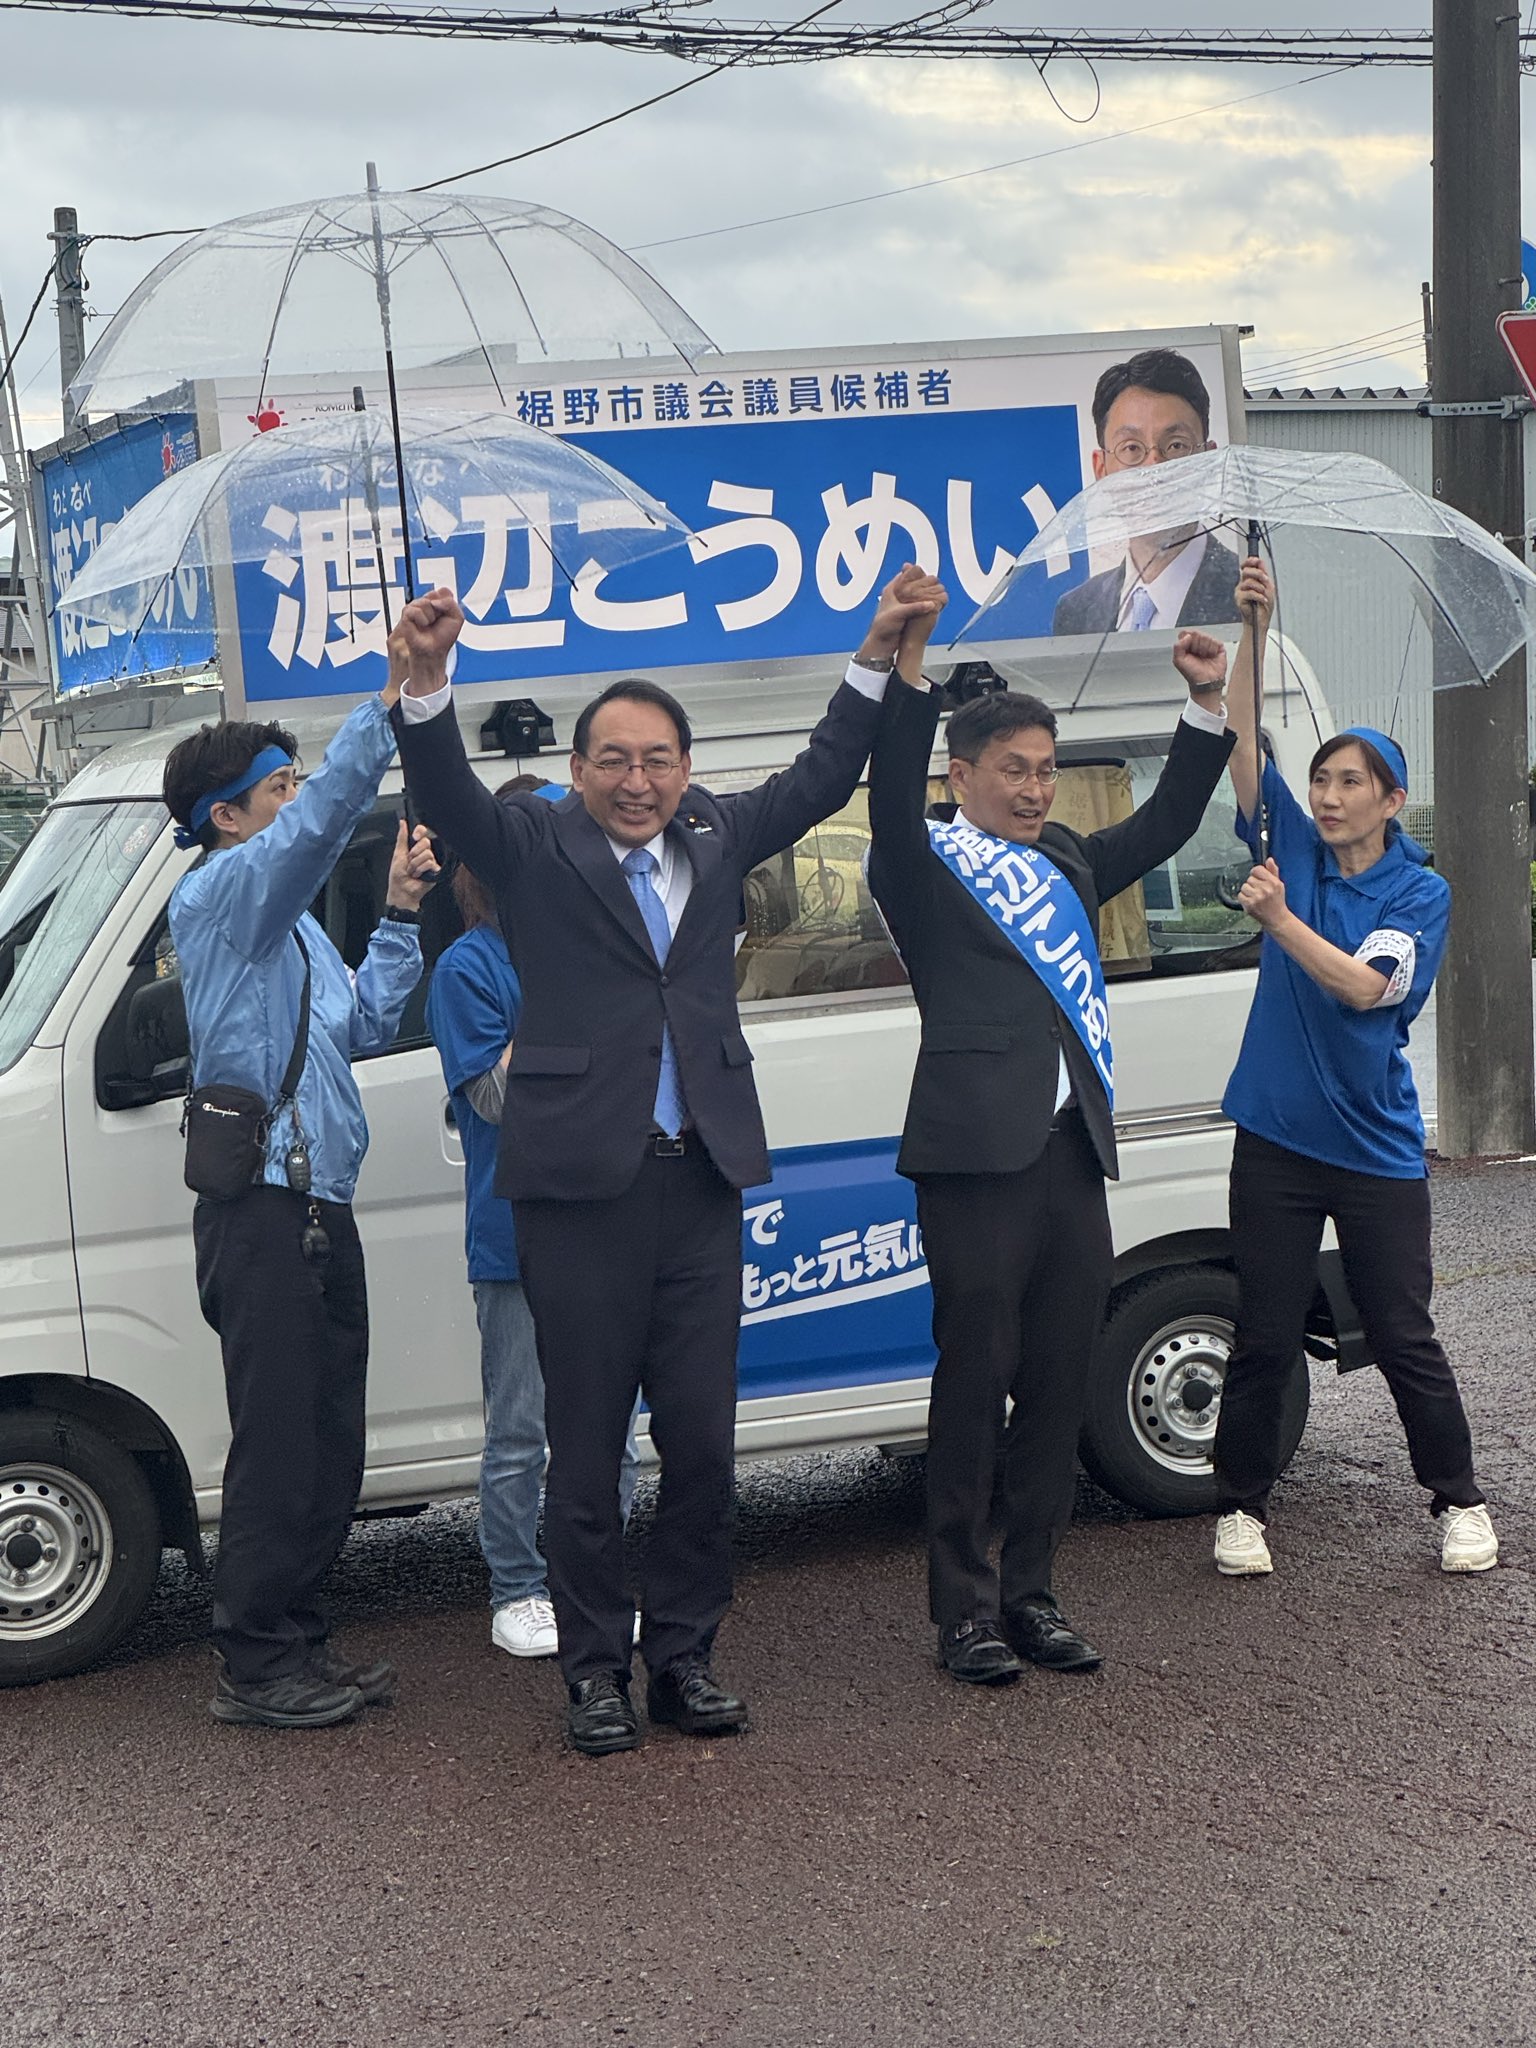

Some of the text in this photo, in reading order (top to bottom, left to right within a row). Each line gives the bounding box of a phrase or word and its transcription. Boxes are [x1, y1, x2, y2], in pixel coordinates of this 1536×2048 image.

[515, 369, 953, 428] 裾野市議会議員候補者
[261, 471, 1071, 671] 渡辺こうめい
[202, 1102, 241, 1118] Champion
